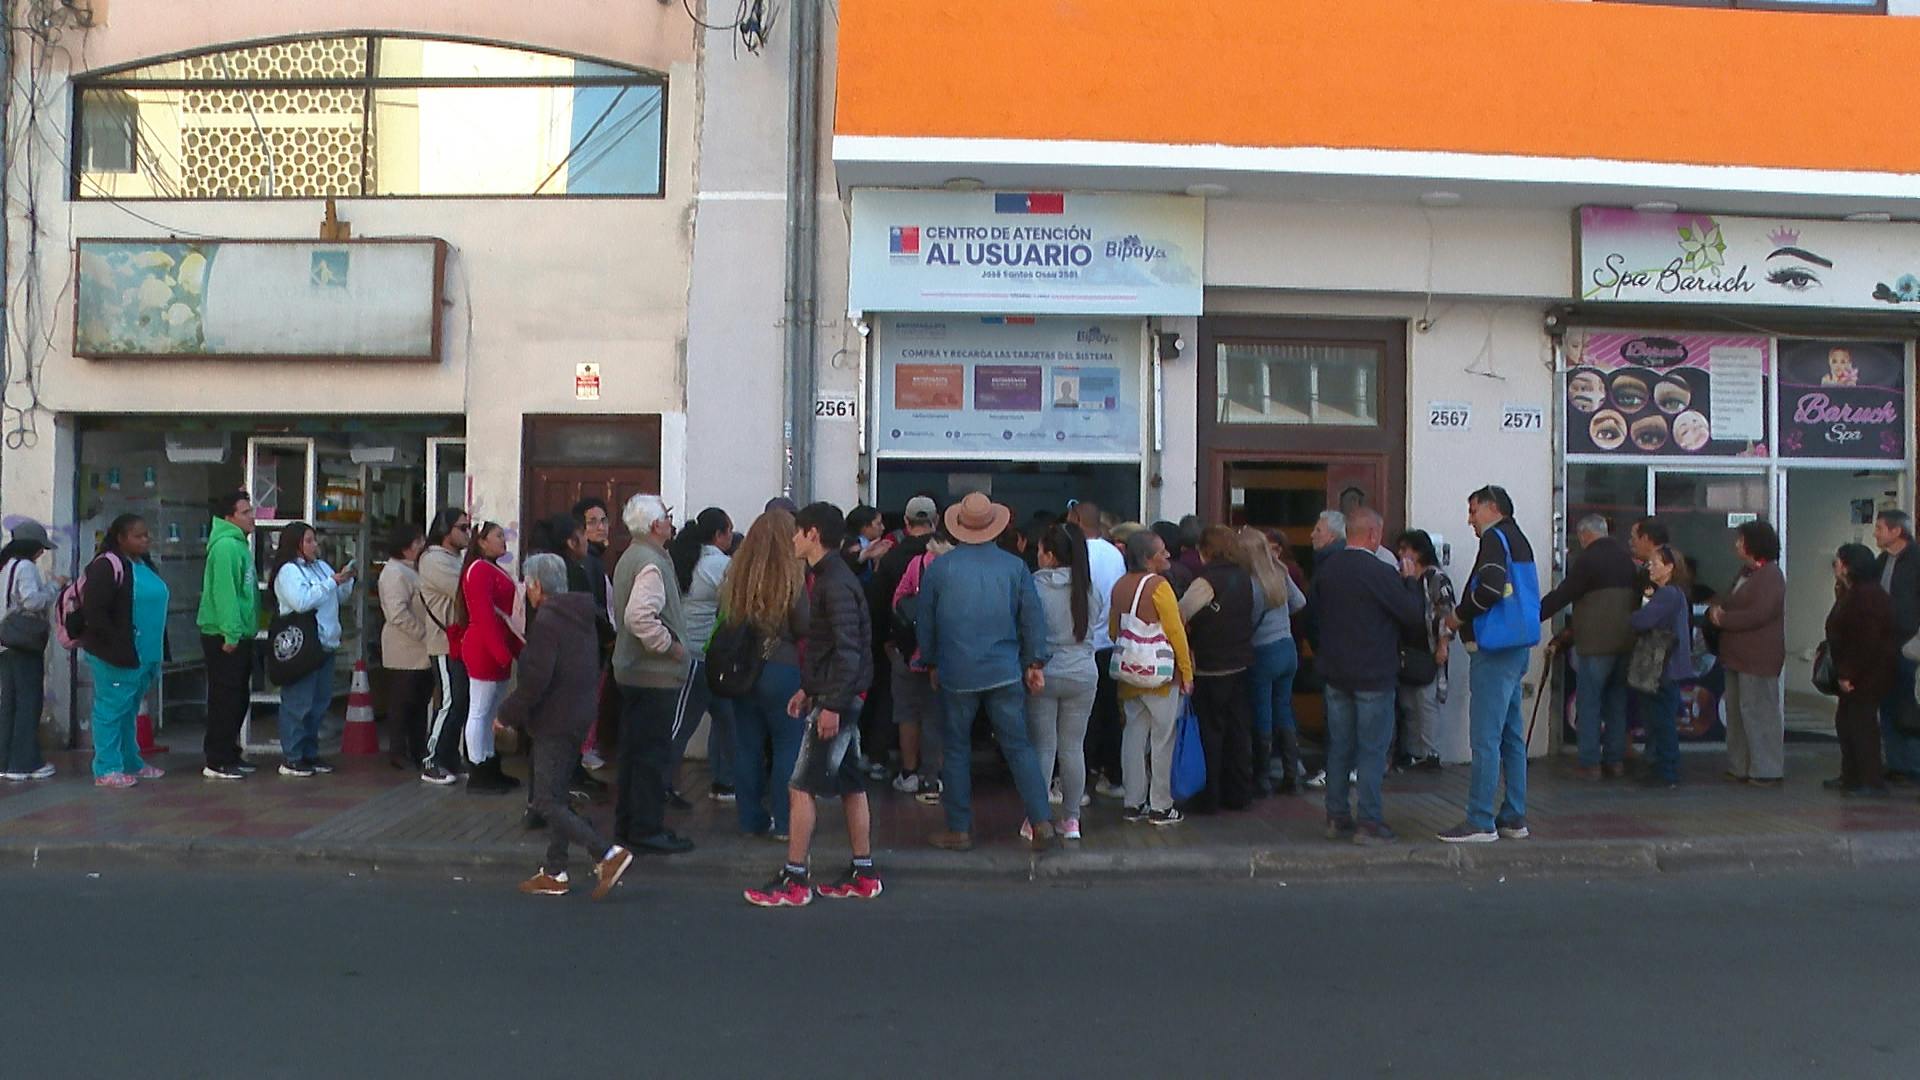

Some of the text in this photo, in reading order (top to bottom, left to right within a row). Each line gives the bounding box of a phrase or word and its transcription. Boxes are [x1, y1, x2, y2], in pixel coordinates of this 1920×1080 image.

[926, 225, 1092, 240] CENTRO DE ATENCIÓN
[926, 243, 1093, 266] AL USUARIO
[1593, 253, 1756, 298] Spa Baruch
[901, 349, 940, 358] COMPRA
[943, 349, 948, 358] Y
[950, 349, 993, 359] RECARGA
[995, 350, 1011, 359] LAS
[1057, 351, 1074, 360] DEL
[1076, 351, 1113, 360] SISTEMA
[816, 401, 855, 417] 2561
[1793, 392, 1897, 424] Baruch
[1431, 411, 1468, 426] 2567
[1504, 413, 1541, 428] 2571
[1825, 423, 1863, 445] Spa
